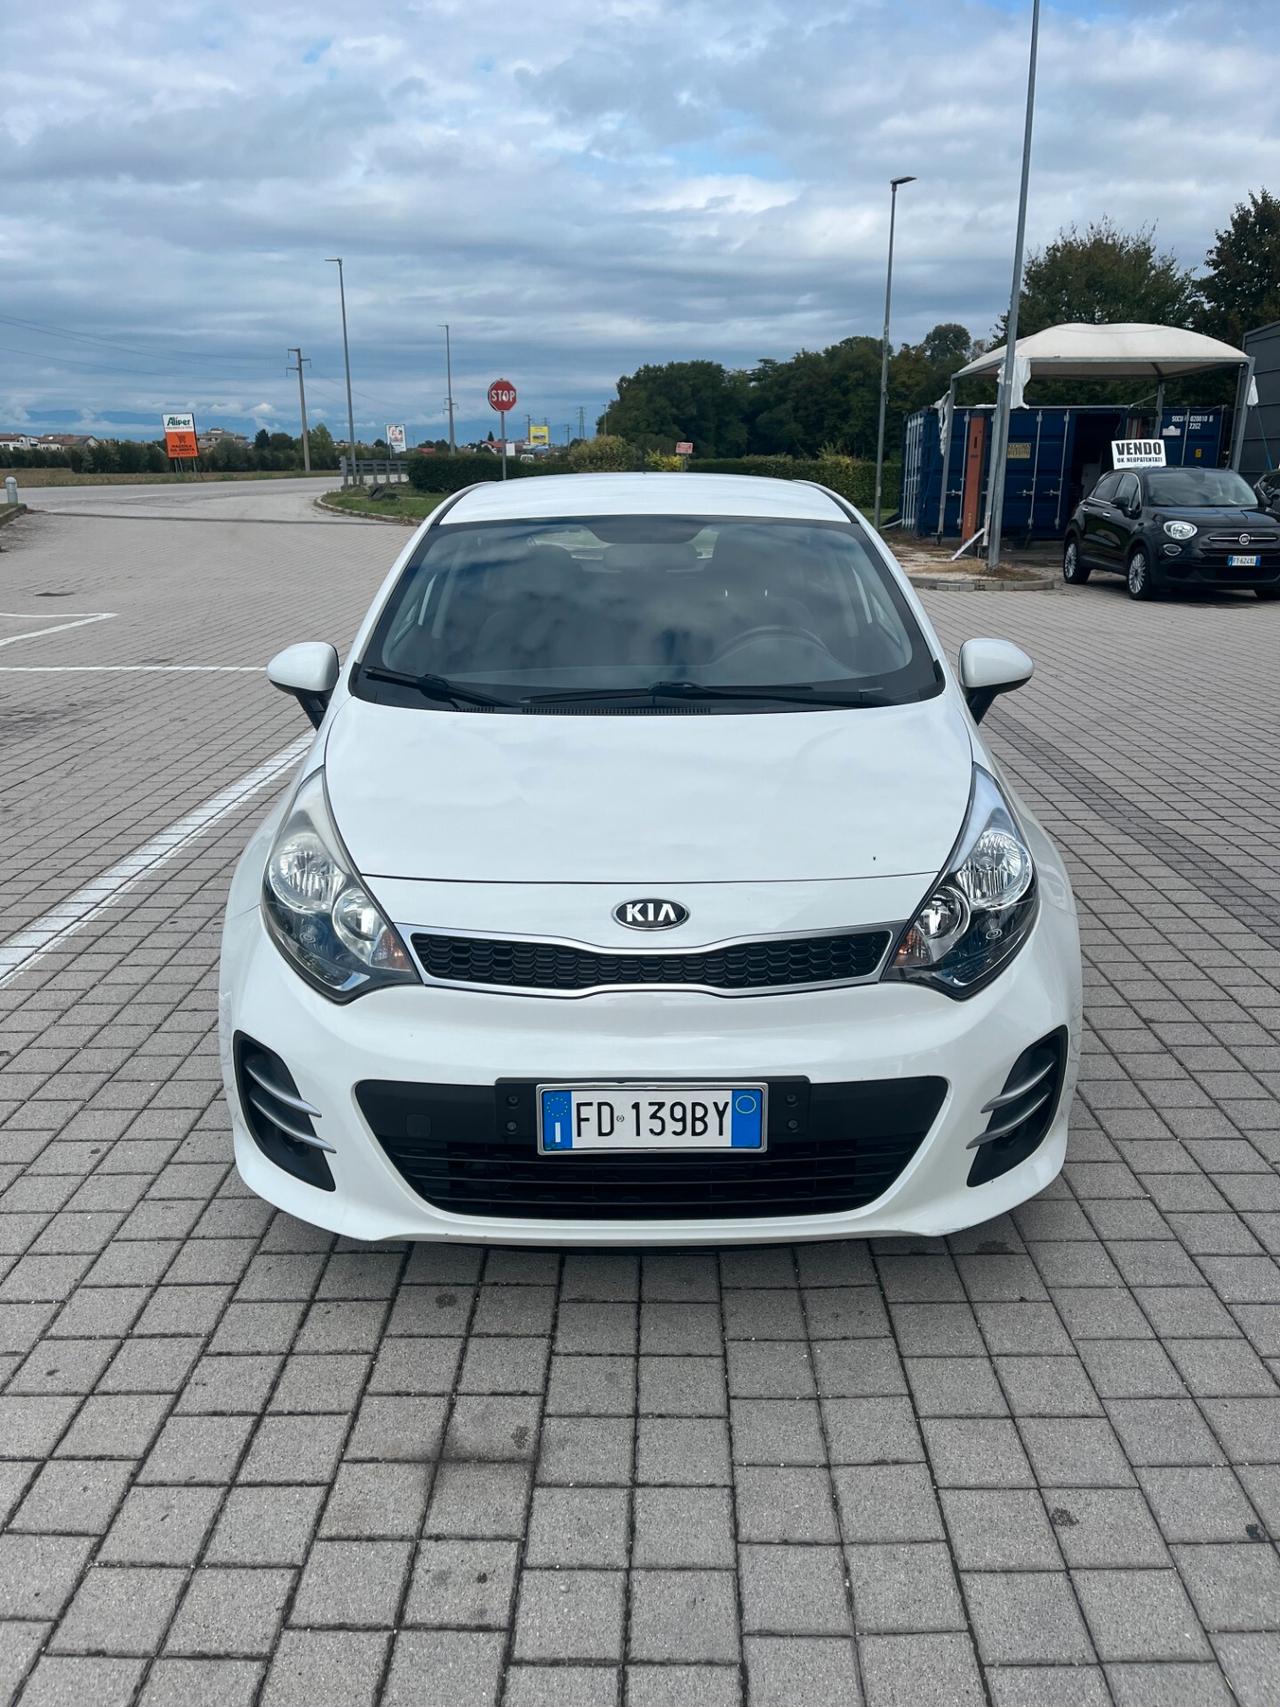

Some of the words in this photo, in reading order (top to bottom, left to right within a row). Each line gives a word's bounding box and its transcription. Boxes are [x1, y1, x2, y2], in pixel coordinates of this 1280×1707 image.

[491, 389, 516, 402] STOP
[1115, 441, 1162, 455] VENDO
[626, 903, 678, 922] KIA
[576, 1101, 615, 1138] FD
[631, 1100, 730, 1137] 139BY
